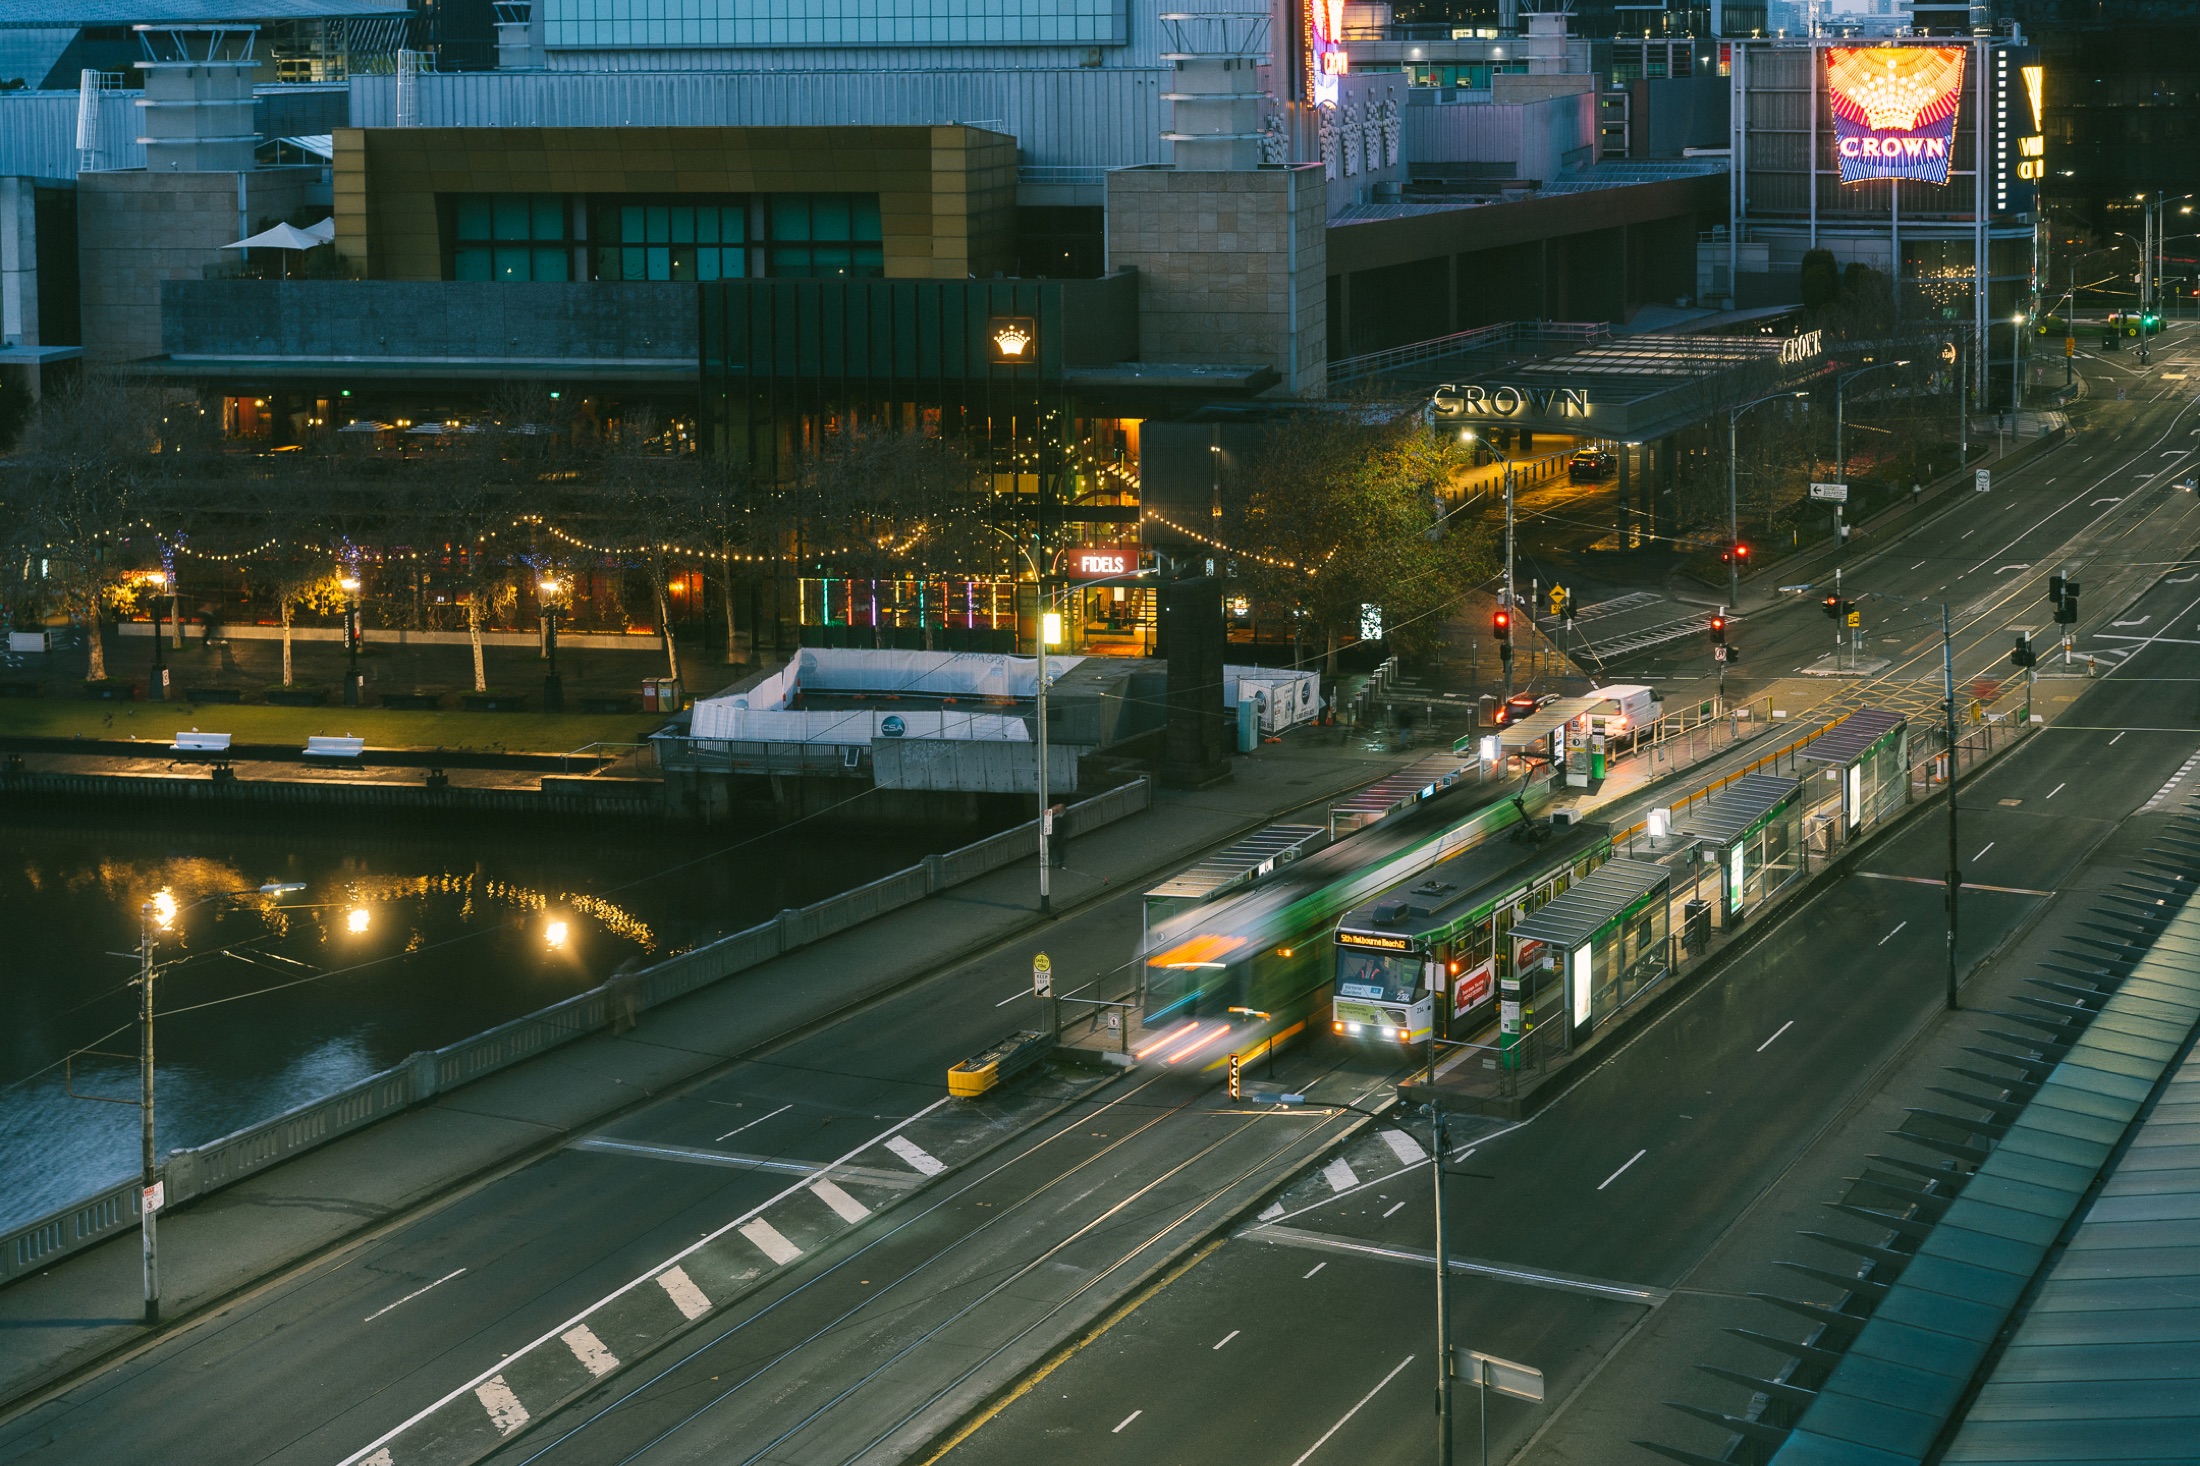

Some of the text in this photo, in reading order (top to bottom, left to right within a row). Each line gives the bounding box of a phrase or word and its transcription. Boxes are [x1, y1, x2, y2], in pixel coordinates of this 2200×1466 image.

[1839, 137, 1945, 157] CROWN
[1779, 329, 1822, 364] CROWN
[1434, 384, 1588, 419] CROWN
[1081, 556, 1124, 573] FIDELS
[1382, 938, 1398, 948] Beach
